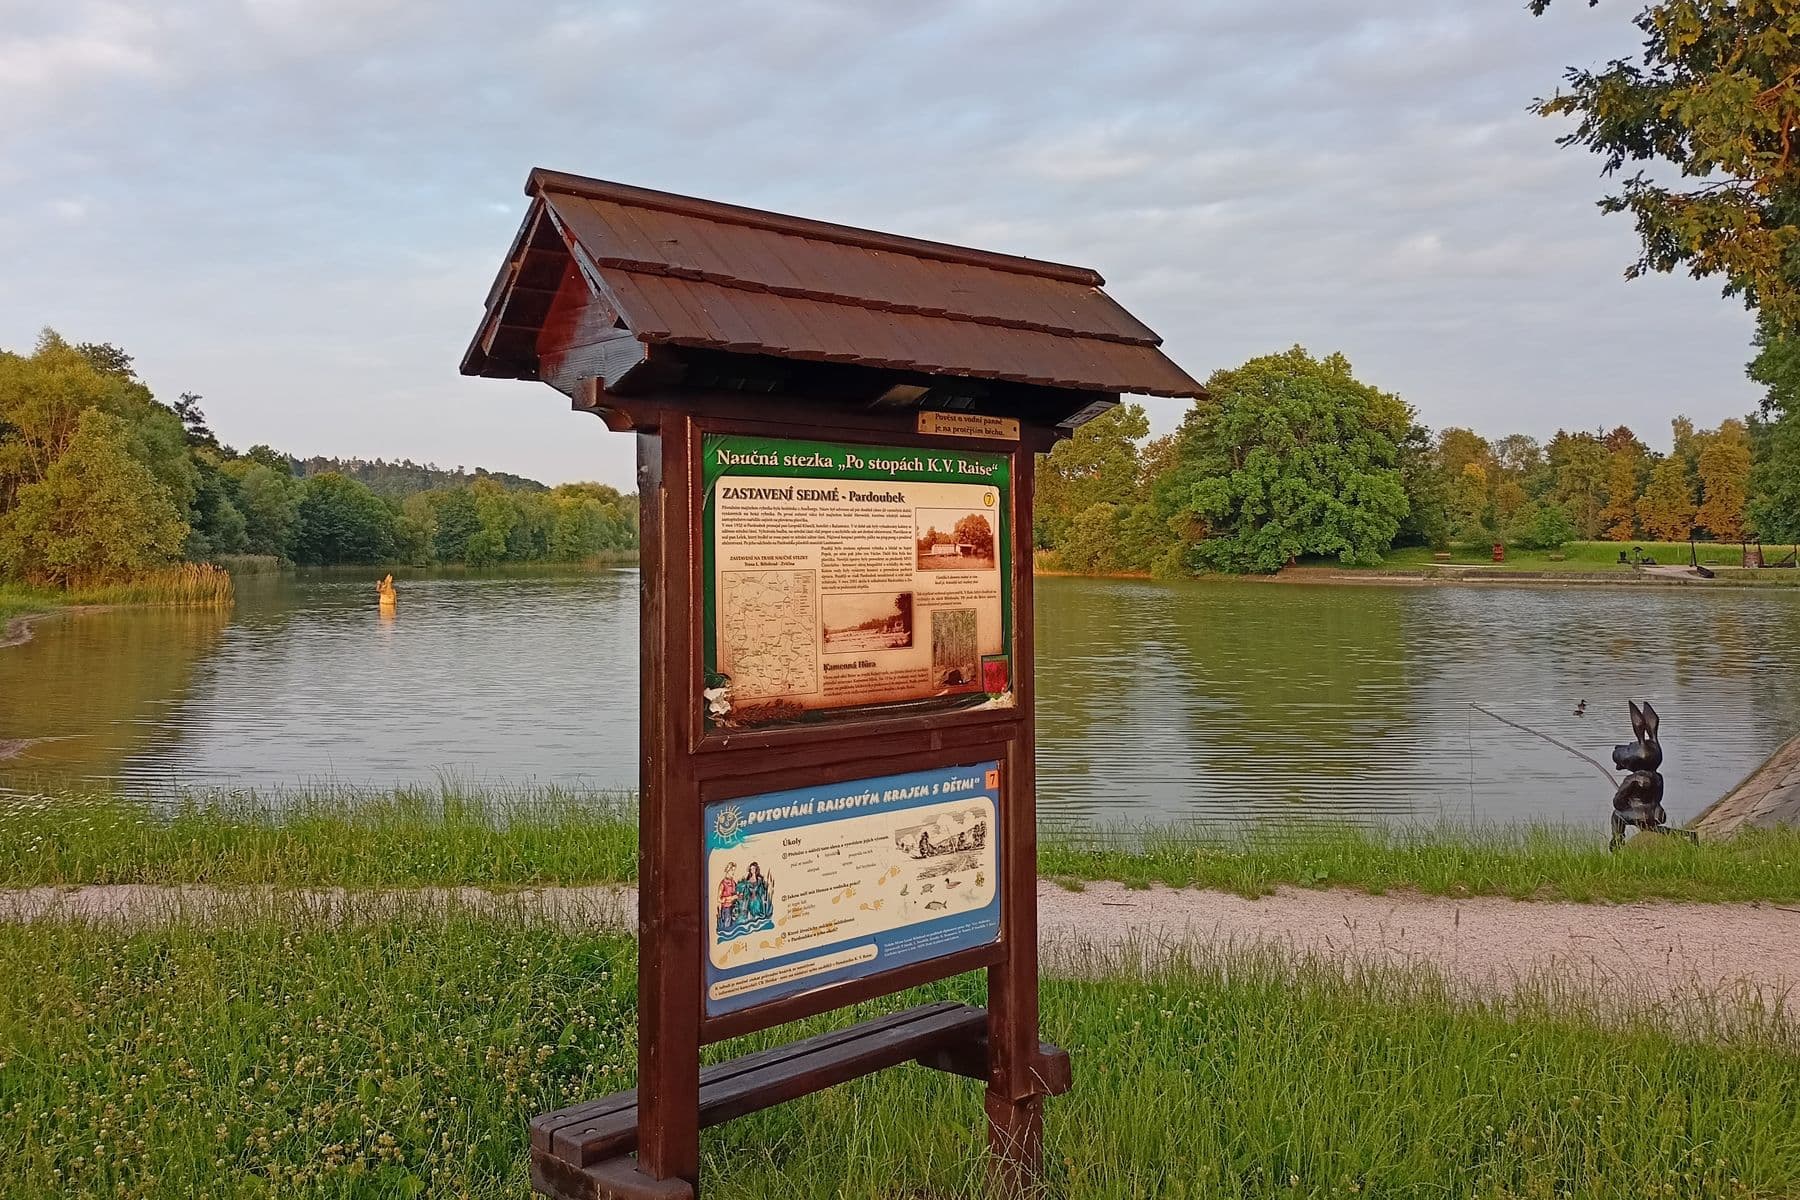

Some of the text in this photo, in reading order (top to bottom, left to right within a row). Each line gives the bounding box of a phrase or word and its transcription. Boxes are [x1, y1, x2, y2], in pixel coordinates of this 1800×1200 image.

[935, 413, 957, 422] Pověst
[963, 415, 982, 424] vodní
[716, 449, 779, 466] Naučná
[783, 453, 833, 468] stezka
[868, 457, 923, 476] stopách
[722, 485, 794, 501] ZASTAVENÍ
[796, 487, 840, 501] SEDMÉ
[848, 490, 906, 503] Pardoubek
[823, 661, 857, 672] Kamenná
[988, 773, 996, 785] 7
[816, 789, 880, 814] RAISOVÝM
[883, 784, 930, 802] KRAJEM
[932, 783, 940, 796] S
[782, 838, 802, 847] Úkoly
